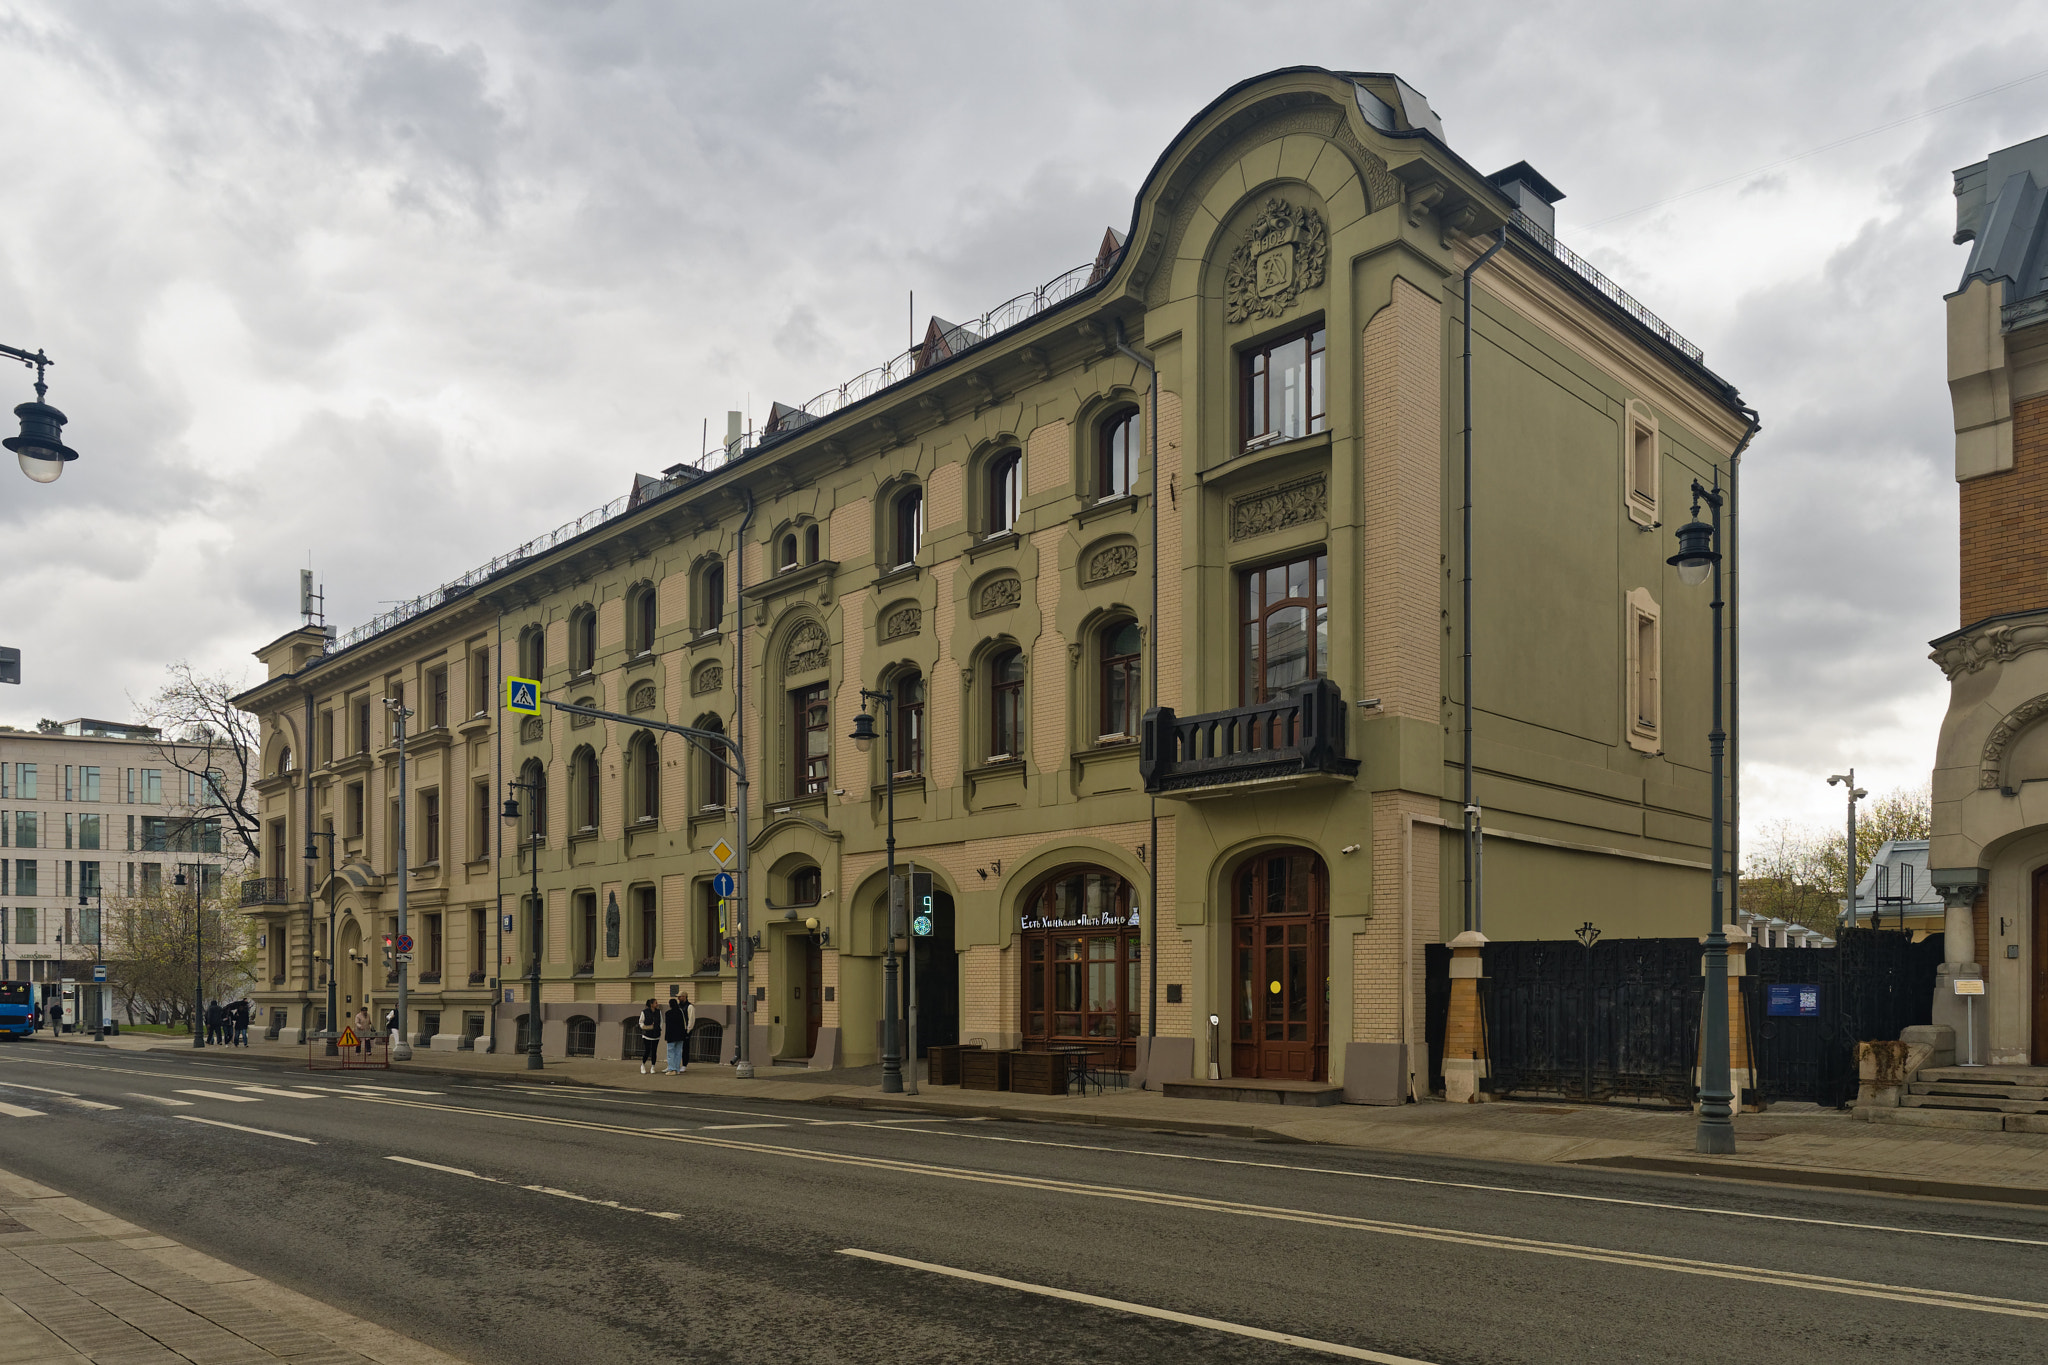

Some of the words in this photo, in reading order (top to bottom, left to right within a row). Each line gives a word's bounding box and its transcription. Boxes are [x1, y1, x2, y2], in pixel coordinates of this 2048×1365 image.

[923, 896, 931, 913] 9
[1021, 915, 1041, 929] Есть
[1042, 915, 1077, 928] Хинкали
[1081, 913, 1100, 926] Пить
[1101, 911, 1126, 925] Вино
